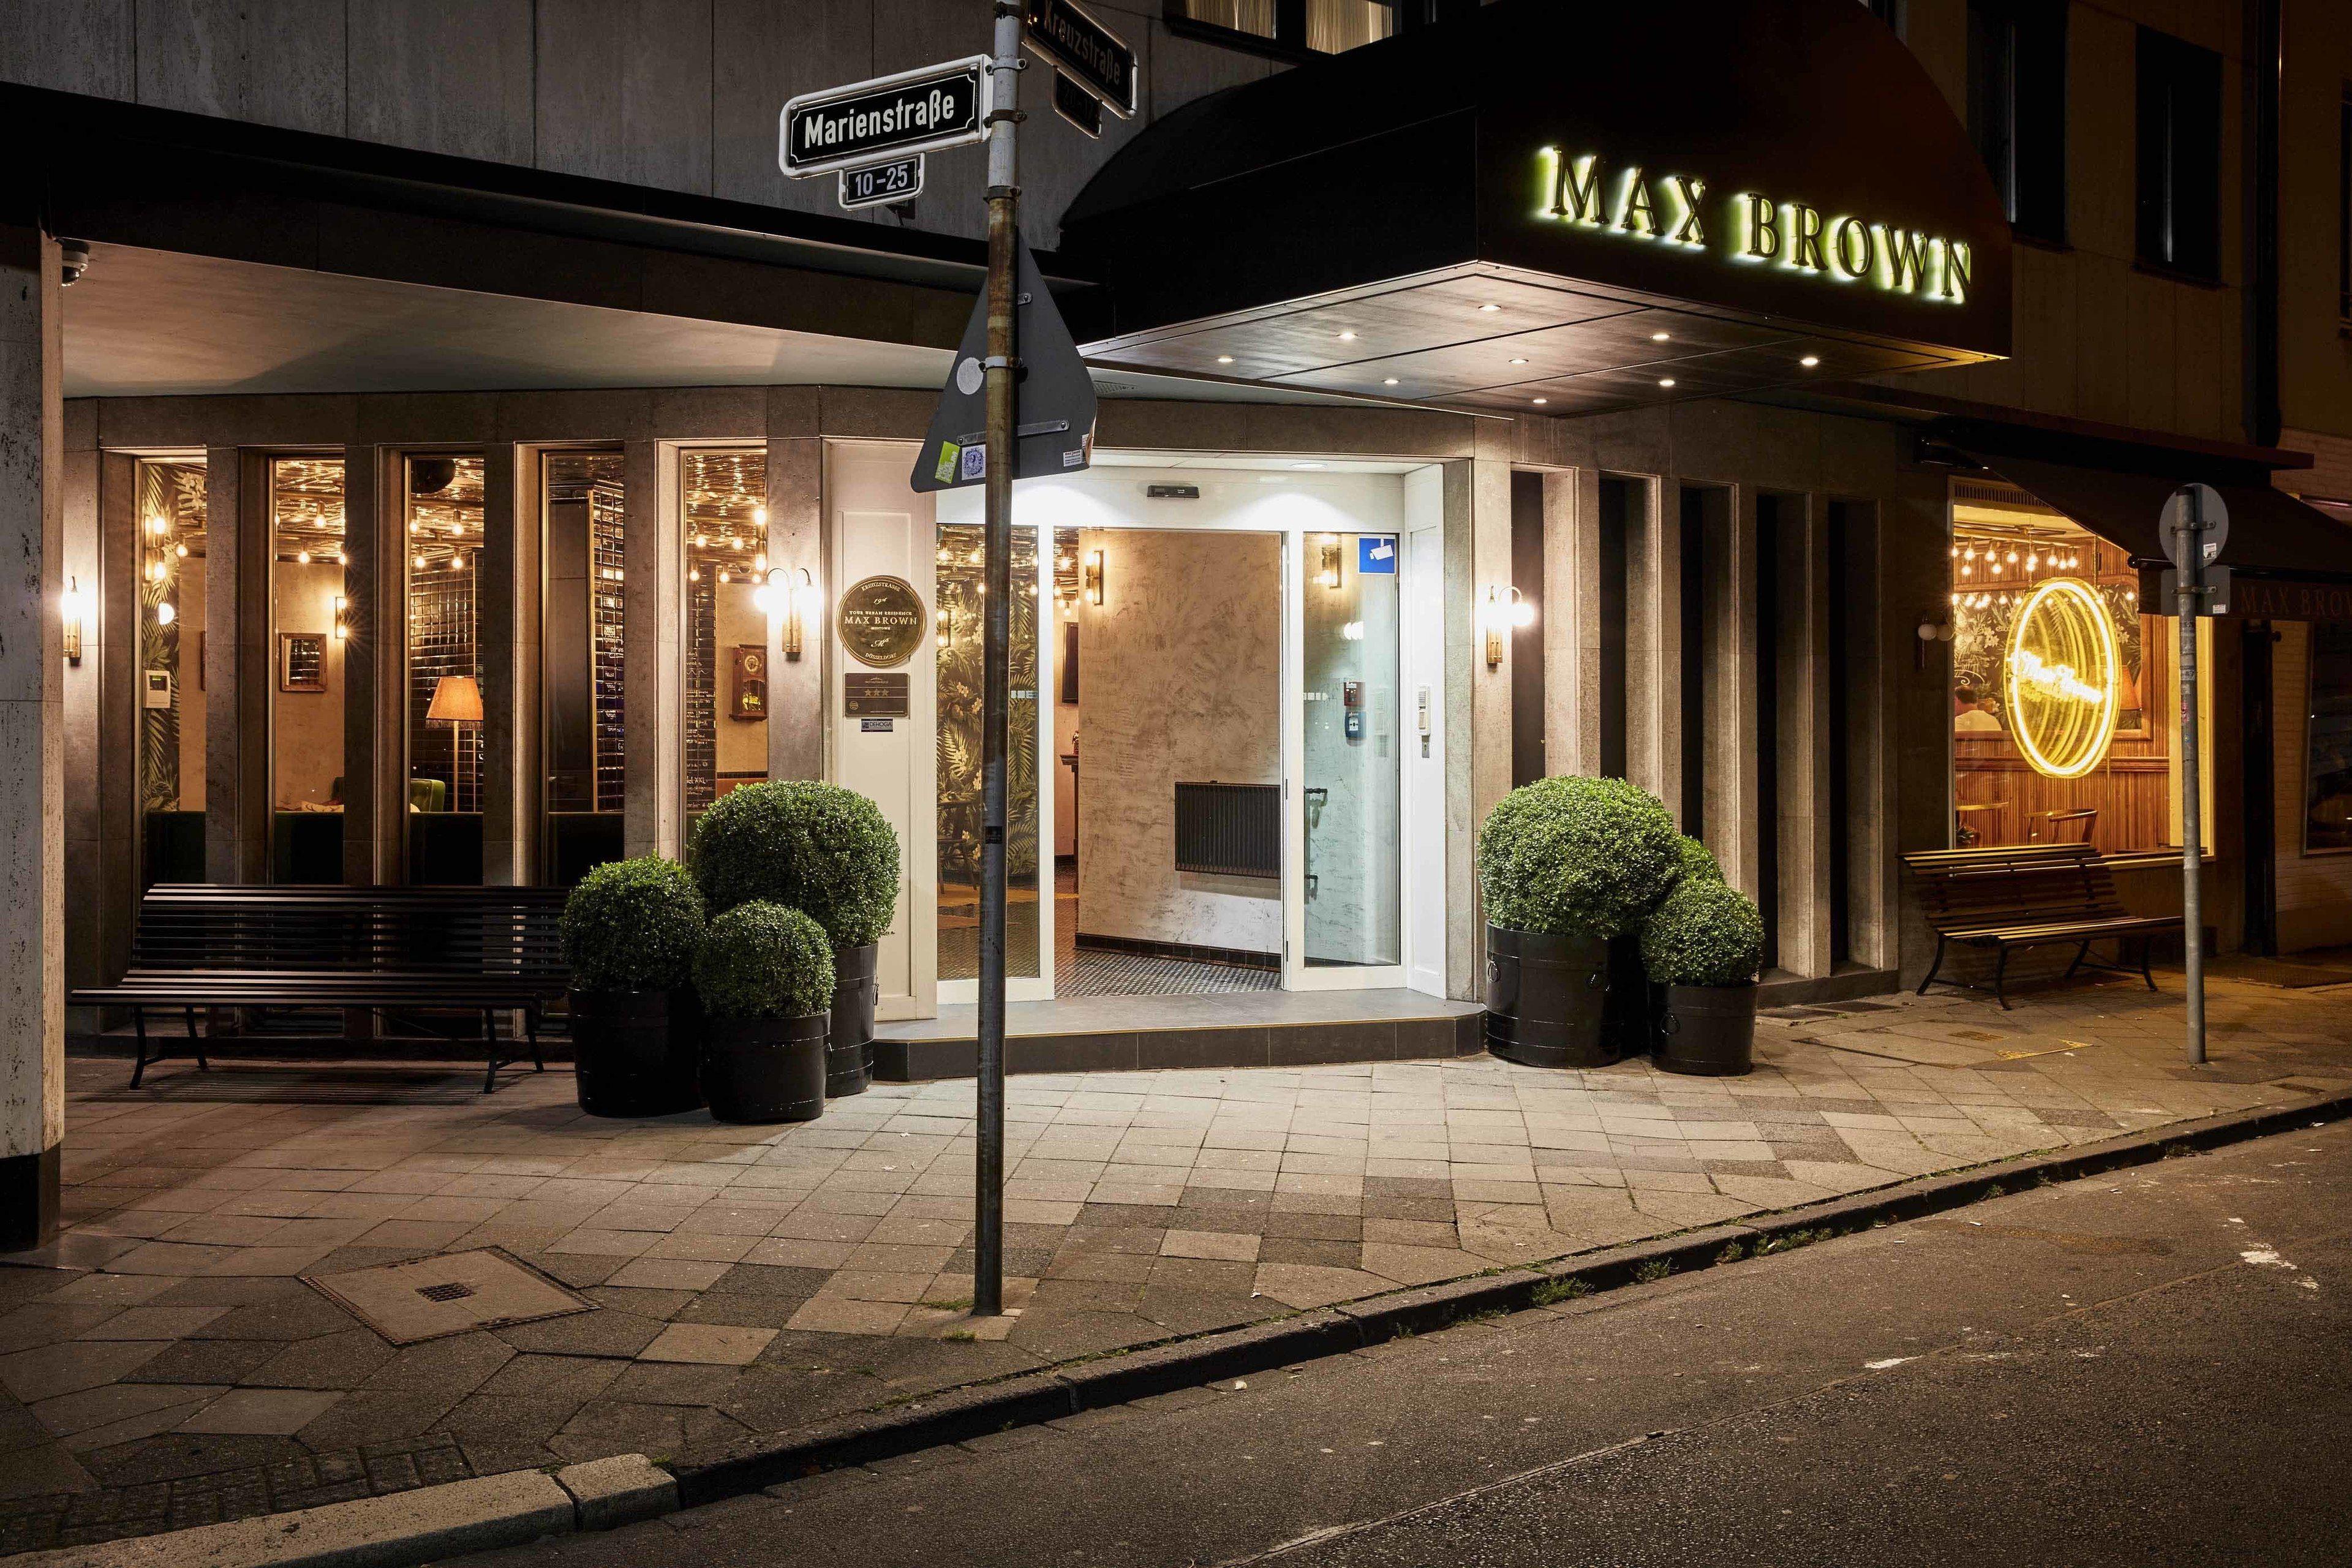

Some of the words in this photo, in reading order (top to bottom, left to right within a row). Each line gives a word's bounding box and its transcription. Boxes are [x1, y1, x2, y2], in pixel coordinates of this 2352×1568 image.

[1044, 0, 1120, 86] Kreuzstraße
[805, 89, 954, 149] Marienstraße
[1547, 145, 1708, 246] MAX
[1744, 192, 1971, 304] BROWN
[861, 582, 901, 592] KREUZSTRASSE
[844, 616, 870, 625] MAX
[874, 616, 918, 625] BROWN
